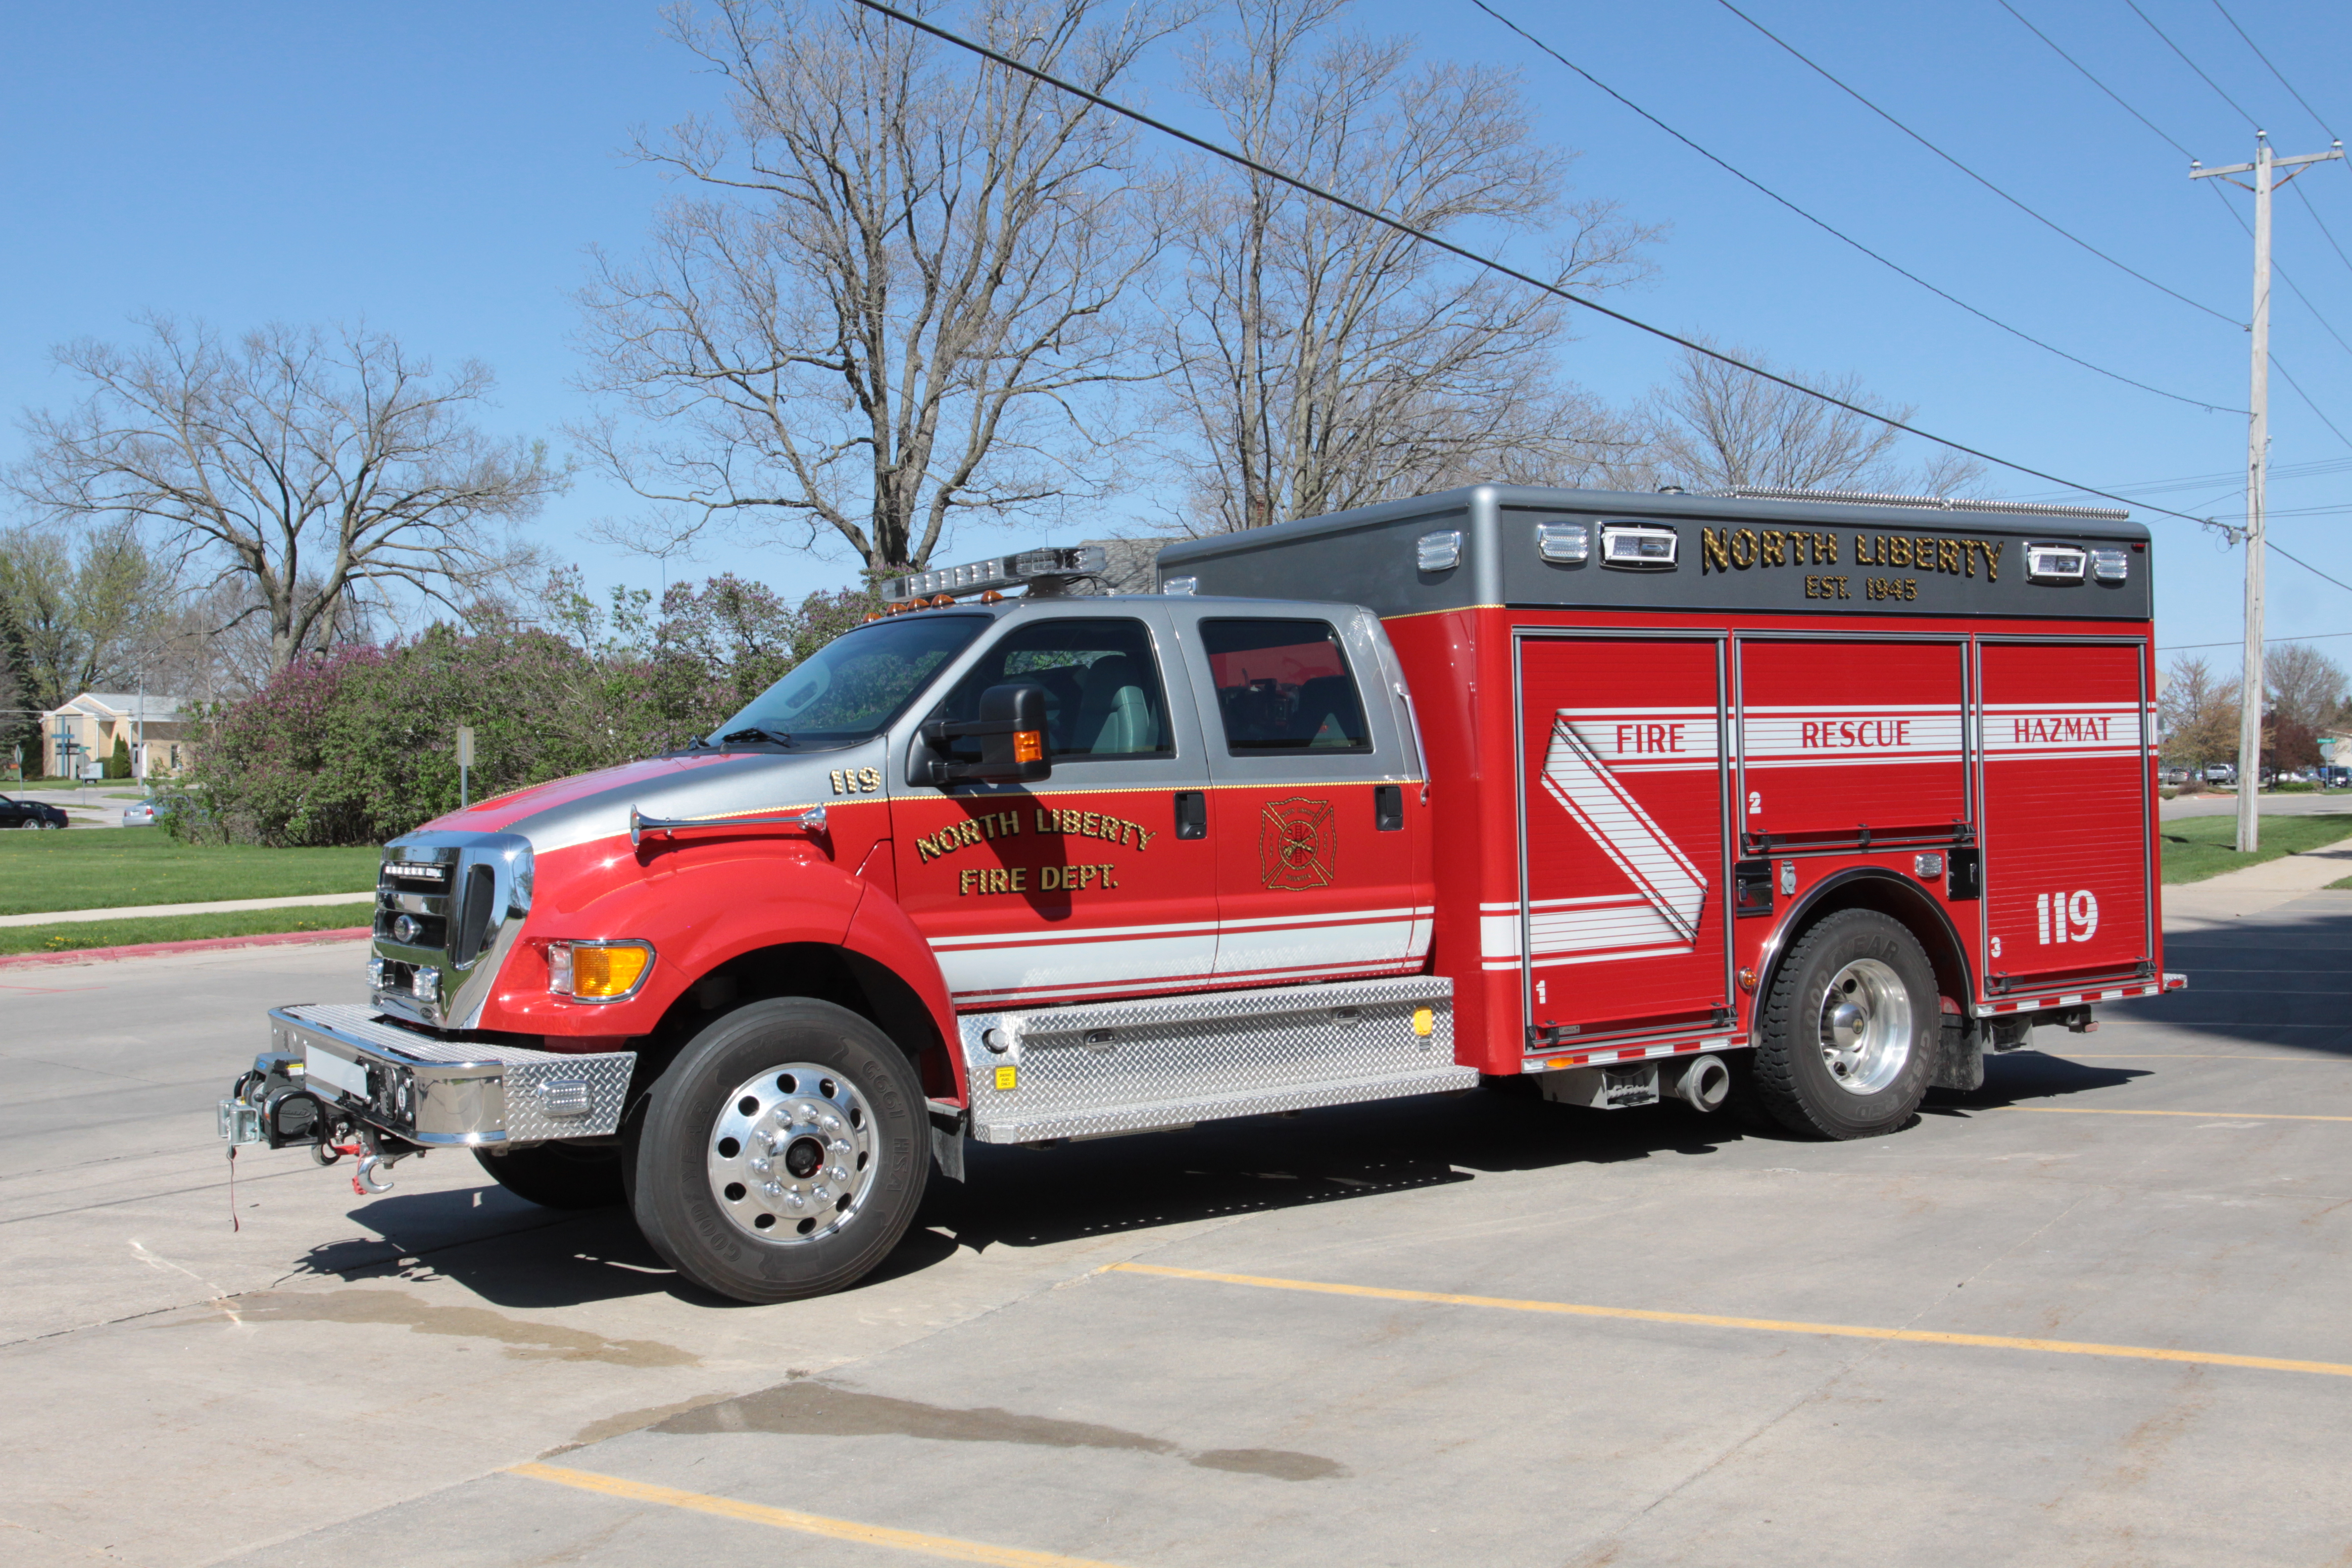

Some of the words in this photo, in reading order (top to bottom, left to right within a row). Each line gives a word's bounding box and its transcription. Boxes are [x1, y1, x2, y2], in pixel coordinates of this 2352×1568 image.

[1702, 527, 1837, 576] NORTH
[1855, 535, 2004, 583] LIBERTY
[1805, 575, 1851, 599] EST.
[1866, 577, 1917, 601] 1945
[1617, 724, 1686, 753] FIRE
[1802, 721, 1911, 748] RESCUE
[2014, 718, 2111, 743] HAZMAT
[829, 767, 881, 795] 119
[1749, 791, 1761, 814] 2
[916, 810, 1020, 864] NORTH
[1034, 808, 1157, 851] LIBERTY
[960, 868, 1027, 895] FIRE
[1040, 864, 1118, 891] DEPT.
[2037, 890, 2098, 945] 119
[1991, 937, 2001, 958] 3
[1536, 980, 1546, 1004] 1
[862, 1061, 905, 1119] G661
[887, 1138, 909, 1192] HSA
